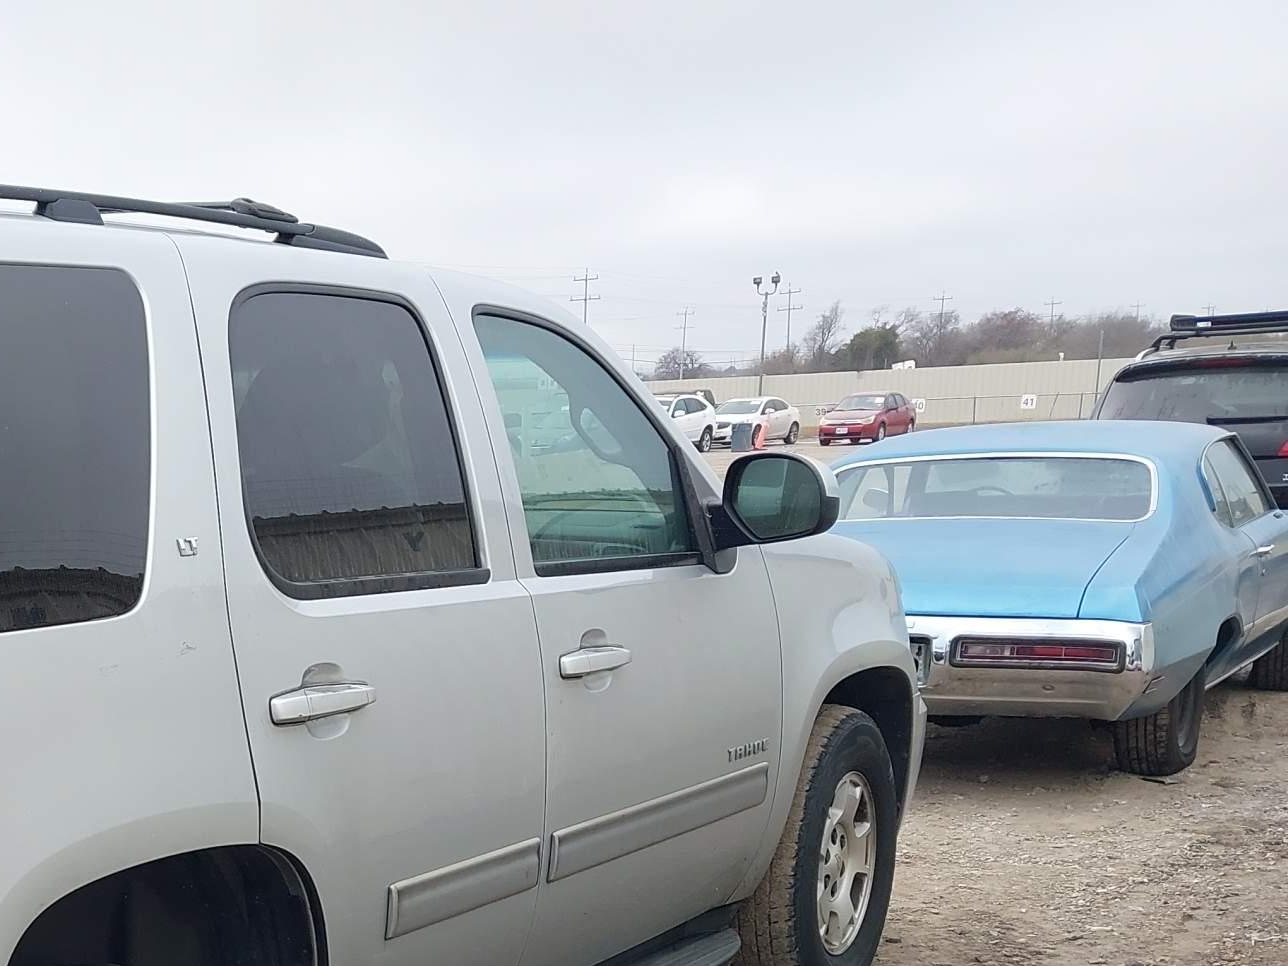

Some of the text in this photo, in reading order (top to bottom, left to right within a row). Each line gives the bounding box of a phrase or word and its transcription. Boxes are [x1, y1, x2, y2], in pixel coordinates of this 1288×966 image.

[1023, 398, 1034, 406] 41
[815, 408, 826, 416] 39
[175, 536, 199, 557] LT
[727, 737, 770, 763] TAHOE
